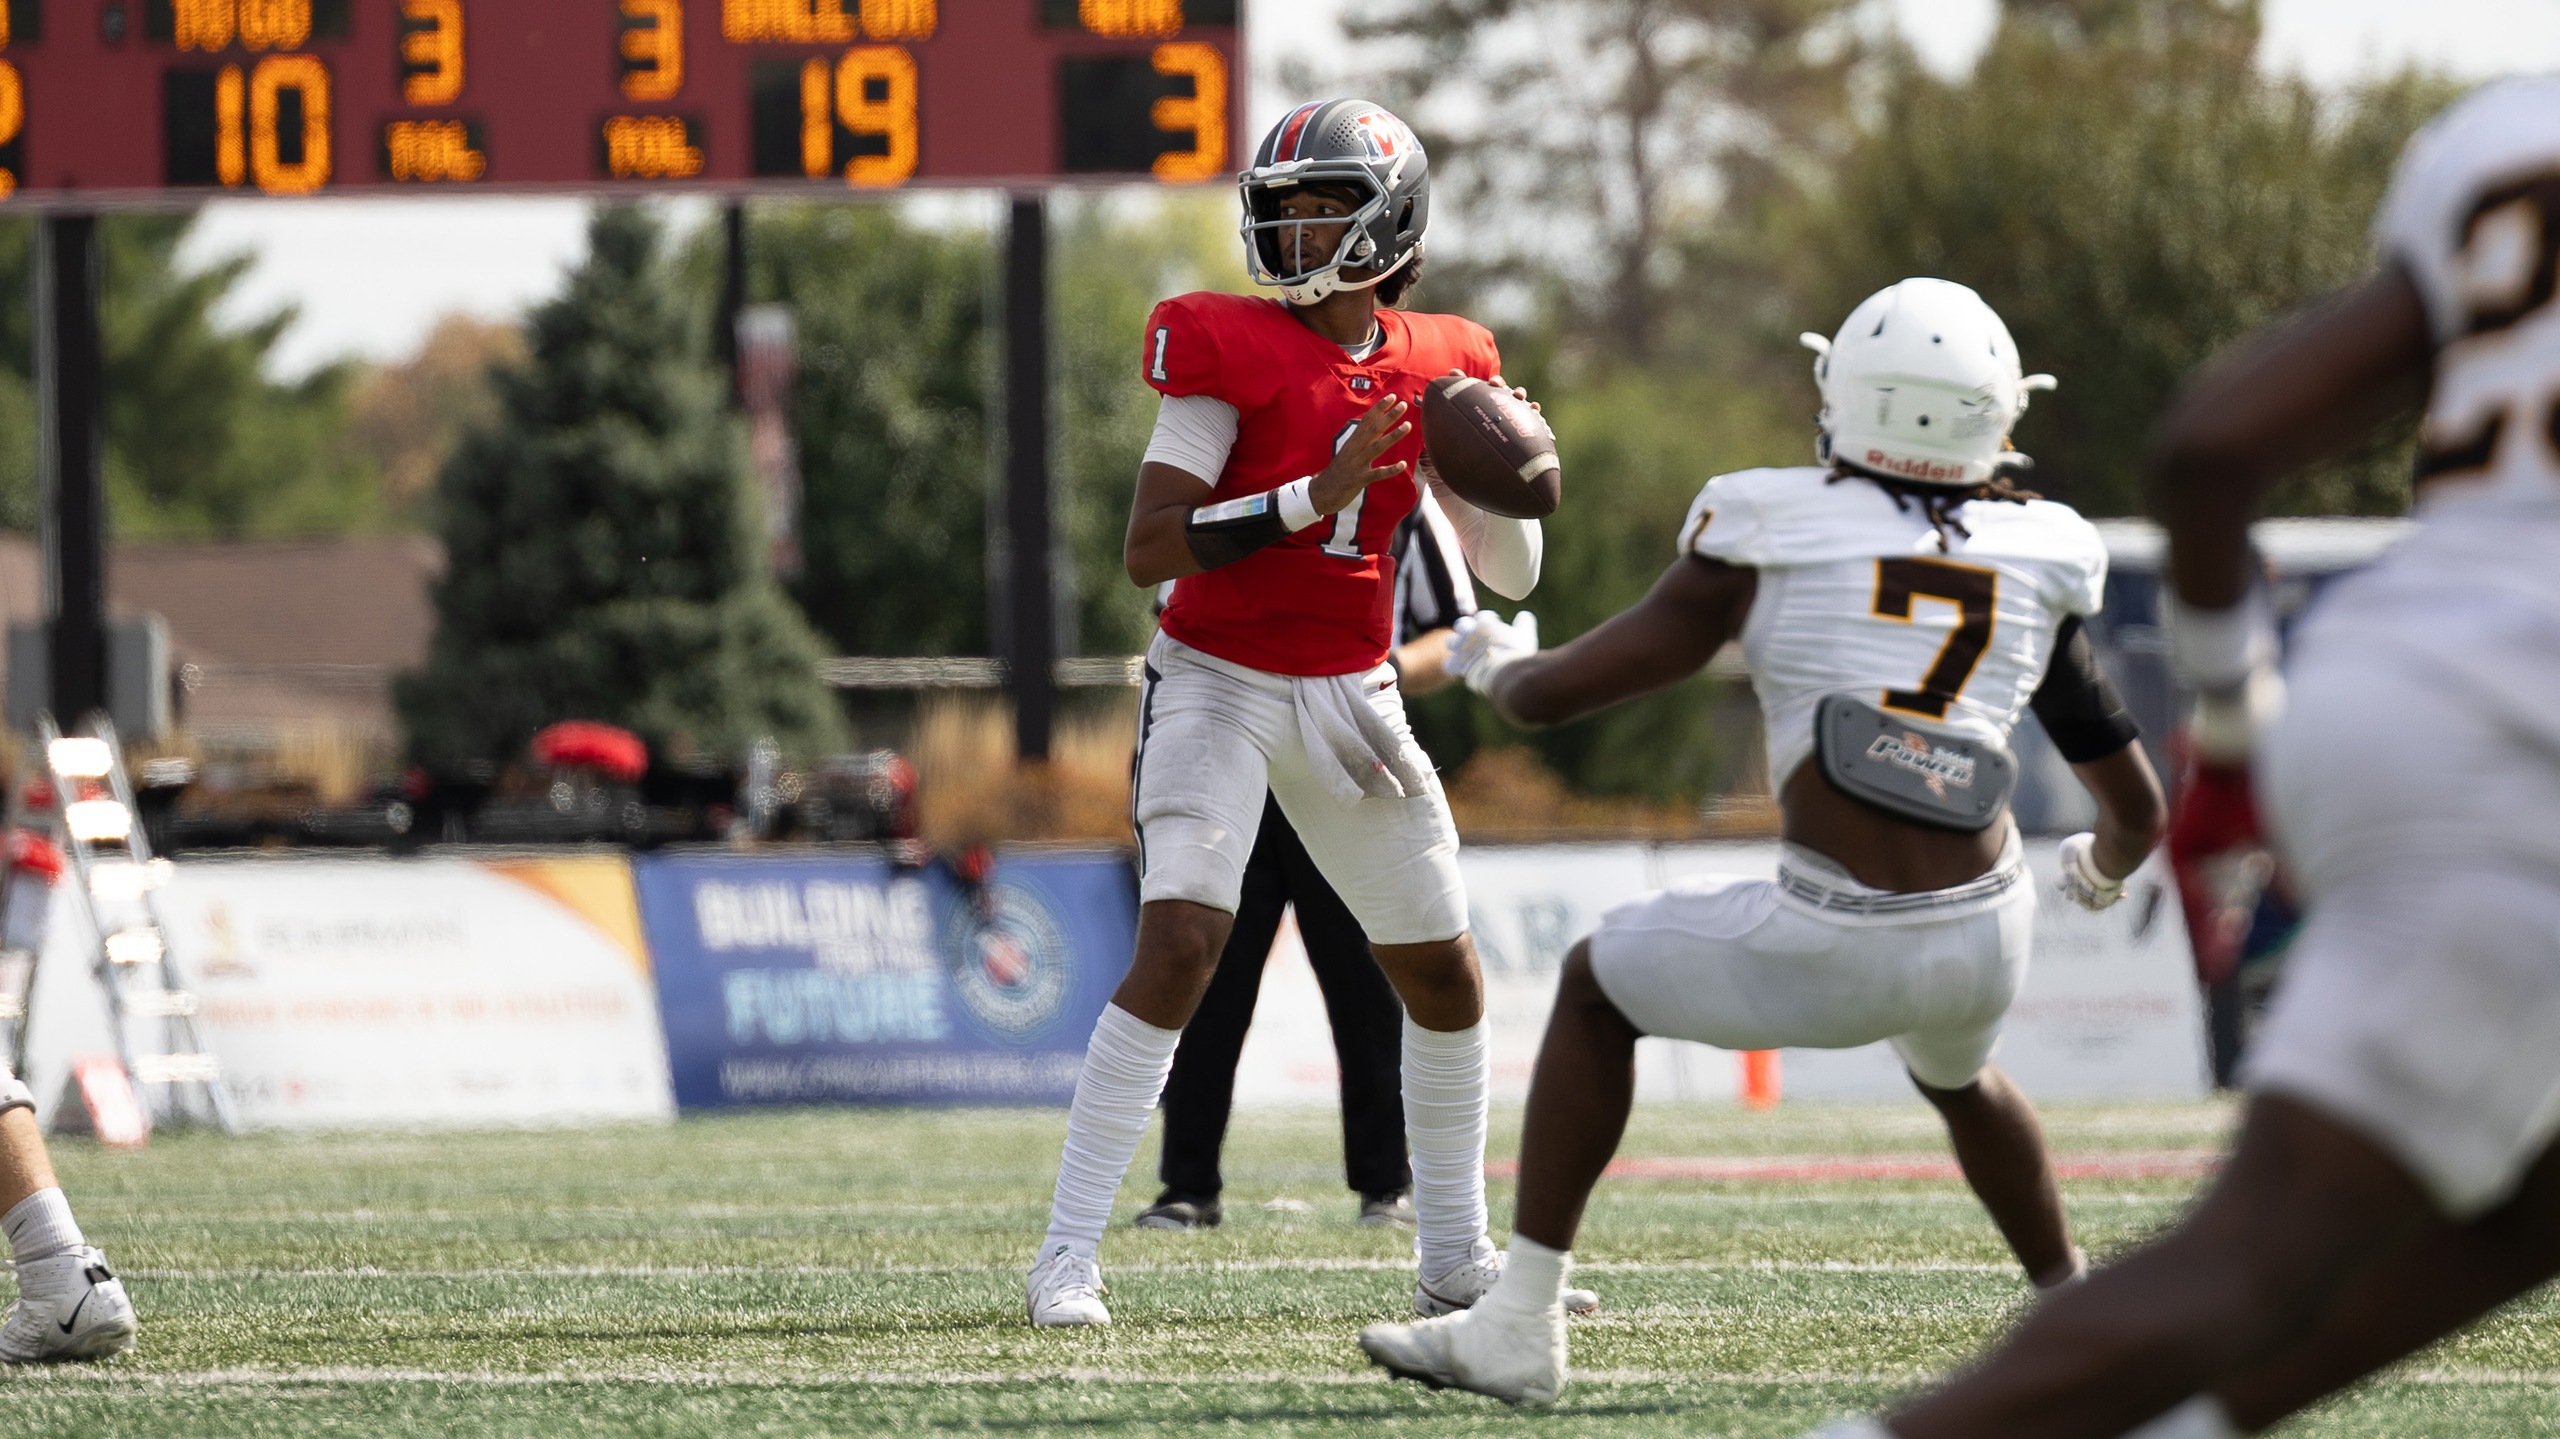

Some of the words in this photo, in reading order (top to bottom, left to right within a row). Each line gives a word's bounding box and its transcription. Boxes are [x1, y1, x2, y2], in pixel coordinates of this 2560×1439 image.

[400, 0, 466, 106] 3
[619, 0, 685, 101] 3
[801, 44, 920, 189] 19
[1150, 41, 1228, 184] 3
[214, 53, 332, 196] 10
[1150, 326, 1170, 383] 1
[1321, 418, 1367, 561] 1
[1865, 449, 1965, 479] Riddell
[1870, 556, 1998, 723] 7
